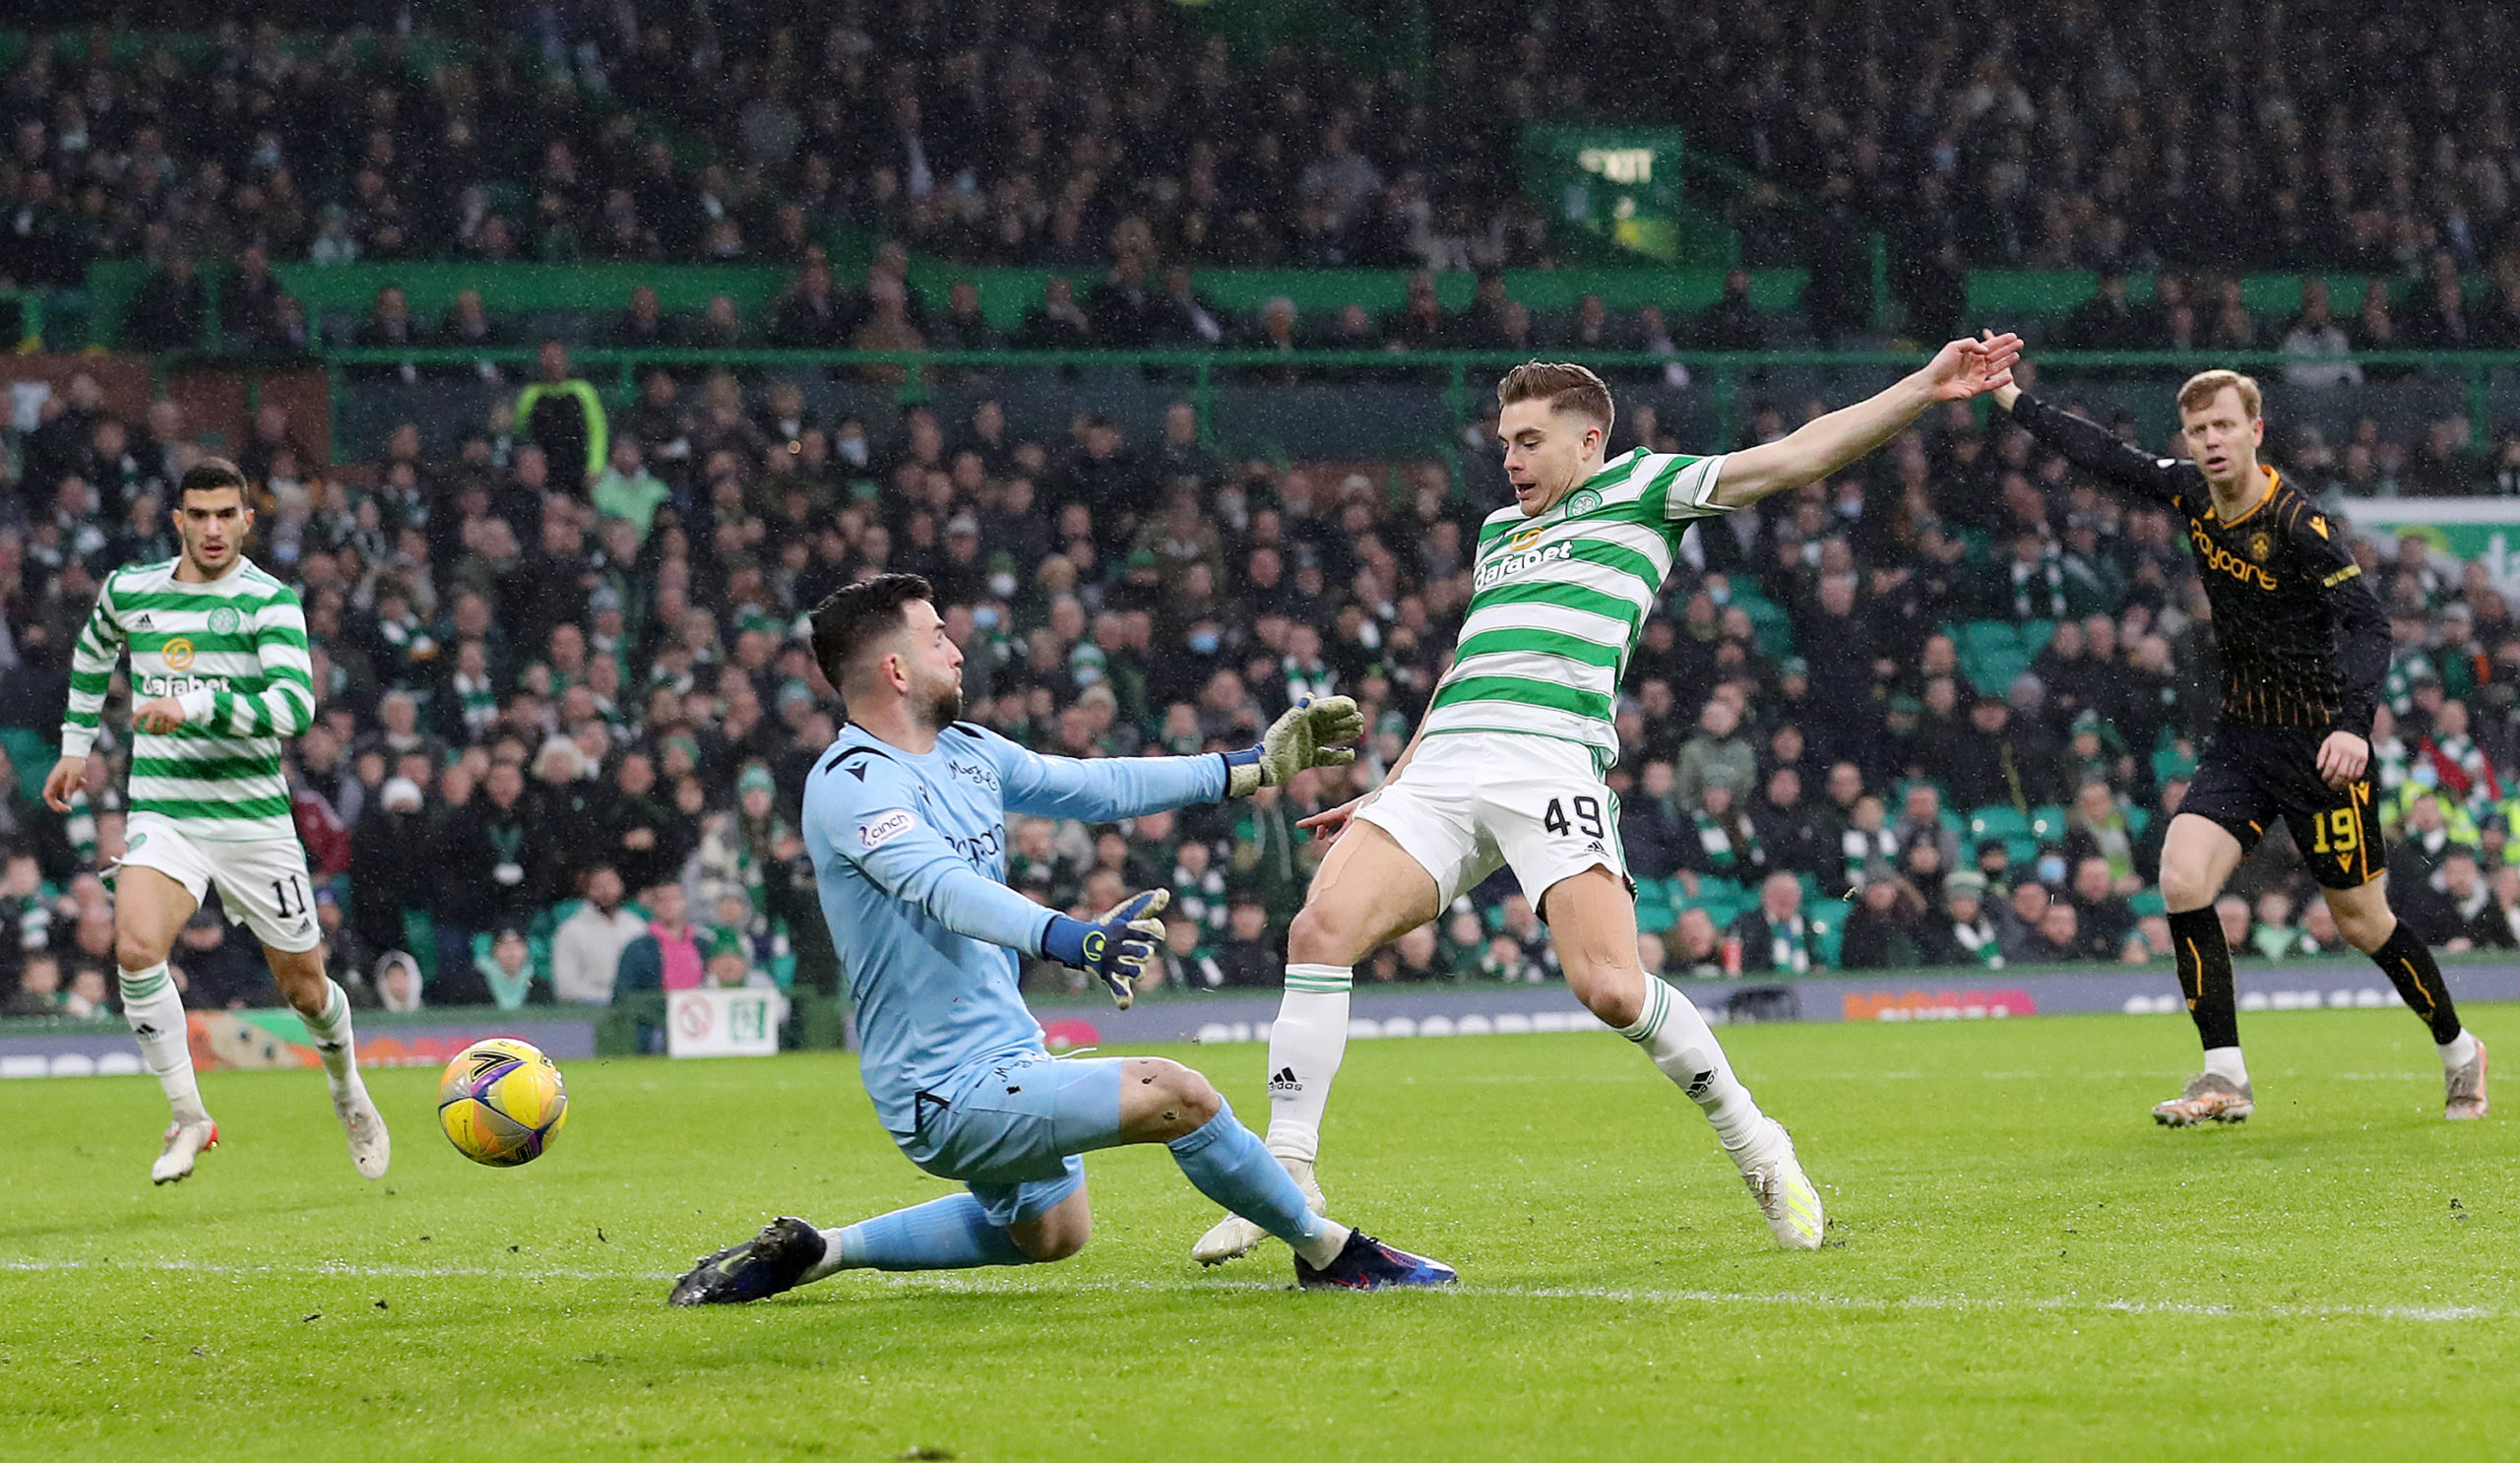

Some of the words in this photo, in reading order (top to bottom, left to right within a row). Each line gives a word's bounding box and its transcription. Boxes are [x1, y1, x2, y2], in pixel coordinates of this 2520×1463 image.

[1476, 540, 1574, 592] dafabet
[871, 814, 910, 839] cinch
[1544, 795, 1605, 840] 49
[2311, 806, 2359, 854] 19
[271, 874, 306, 919] 11
